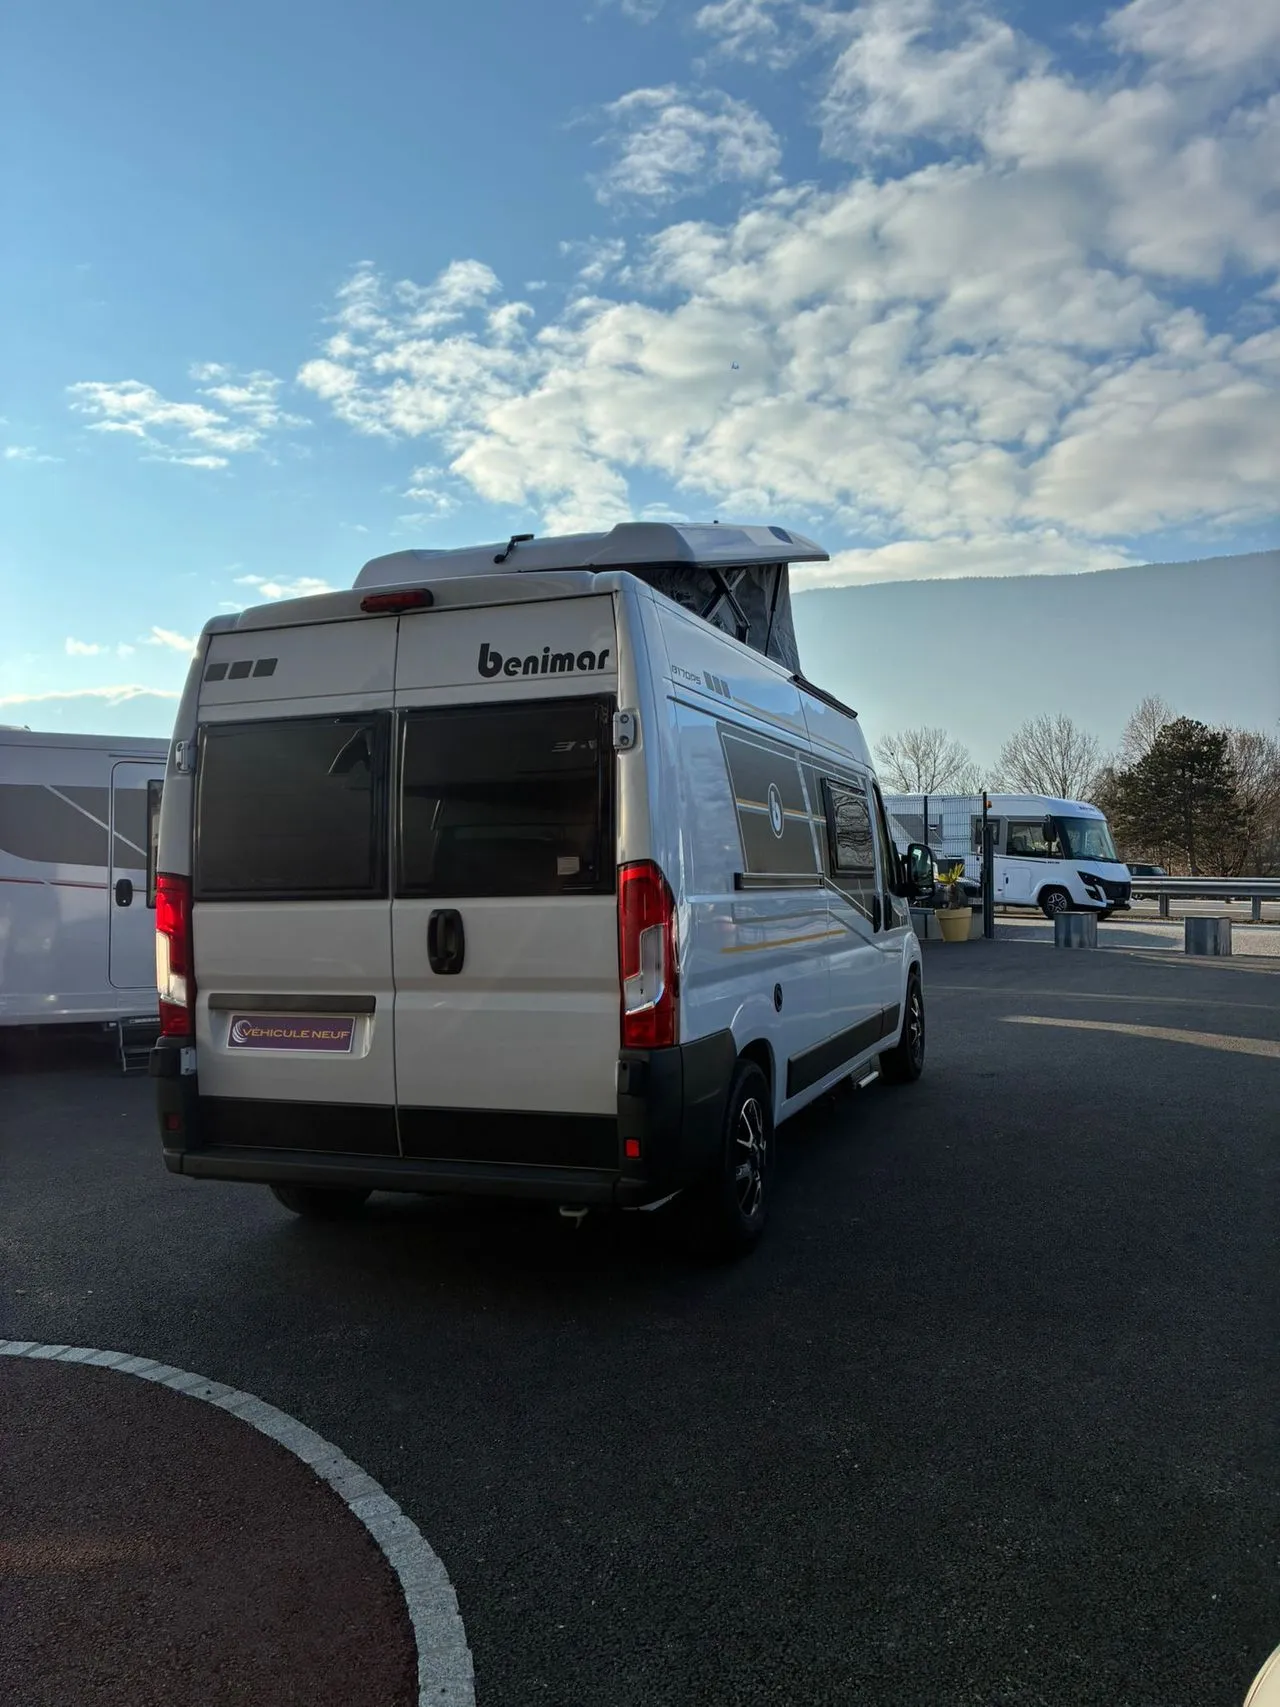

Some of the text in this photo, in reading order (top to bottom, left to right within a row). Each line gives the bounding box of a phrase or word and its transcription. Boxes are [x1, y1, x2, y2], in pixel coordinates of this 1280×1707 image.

[478, 643, 610, 678] benimar
[242, 1027, 351, 1040] VÉHICULE NEUF
